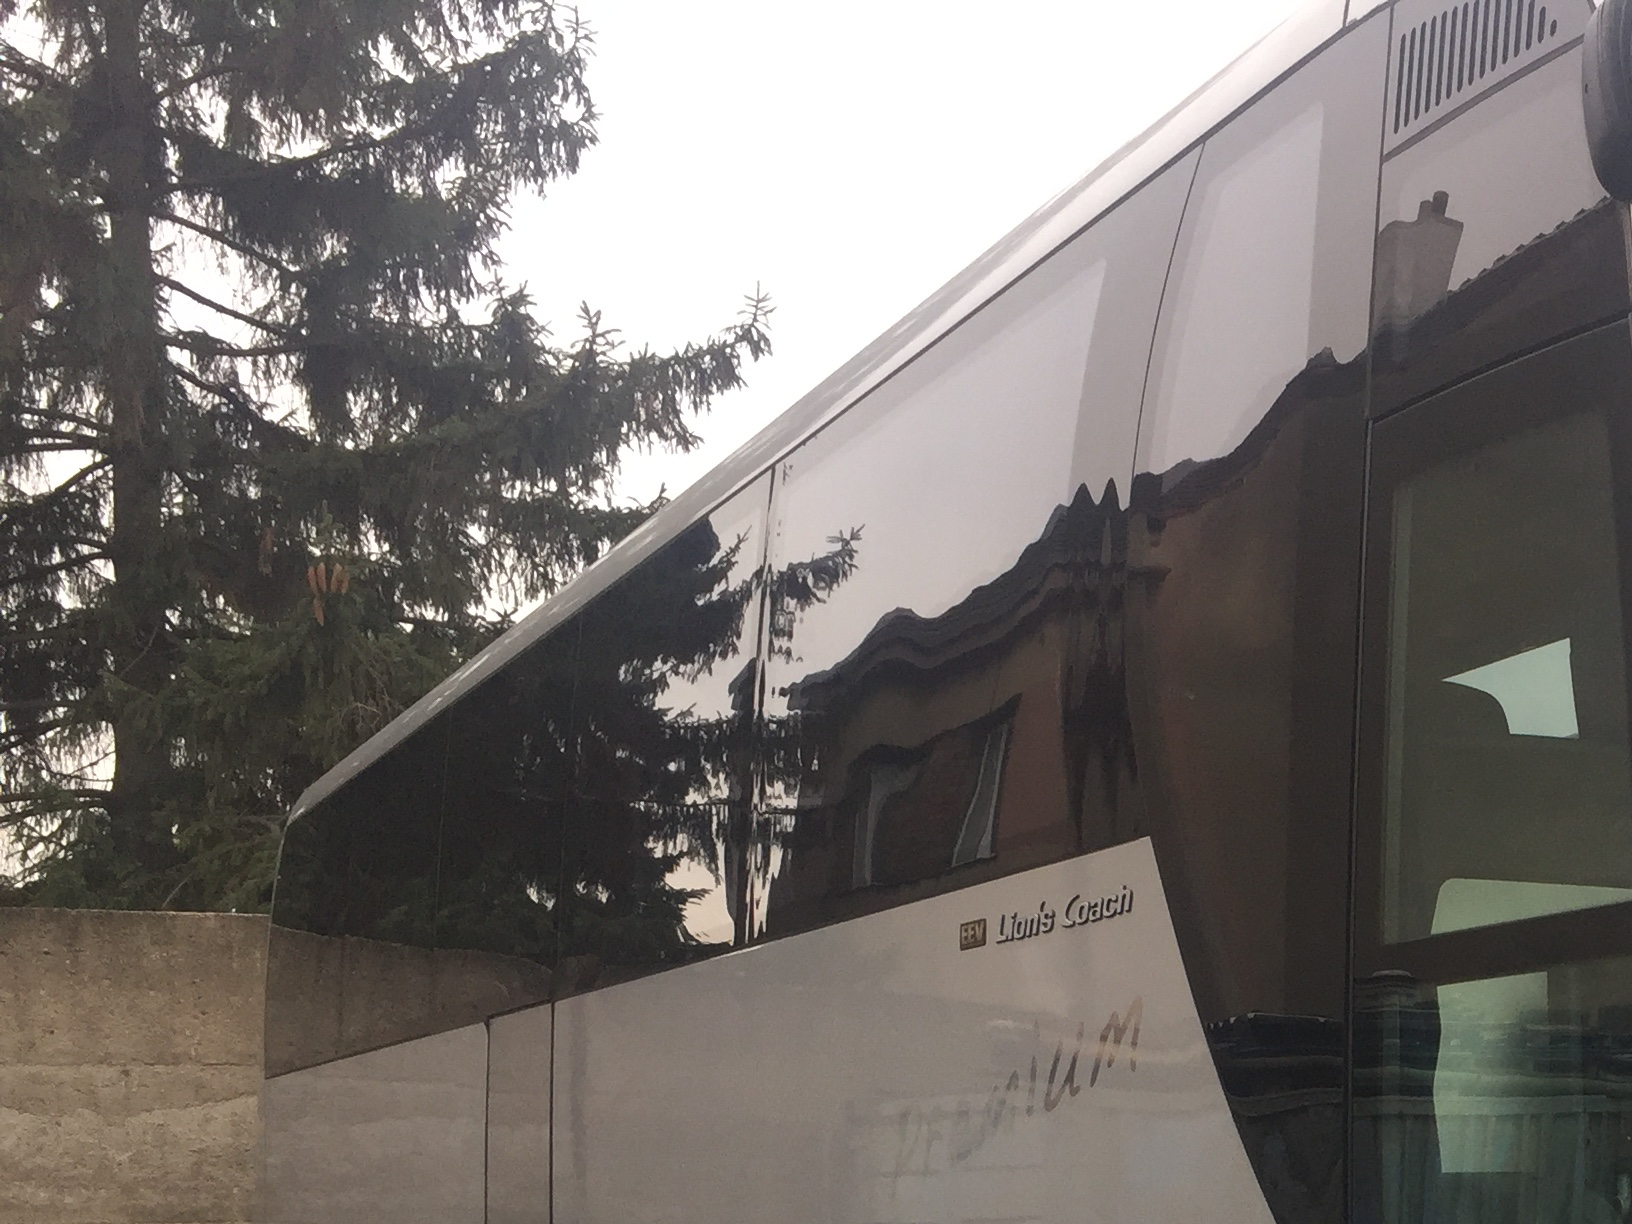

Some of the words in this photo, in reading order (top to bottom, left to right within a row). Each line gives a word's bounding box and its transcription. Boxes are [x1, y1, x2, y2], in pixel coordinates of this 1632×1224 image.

[961, 922, 986, 945] EEV
[996, 901, 1056, 944] Lion's
[1062, 885, 1134, 928] Coach
